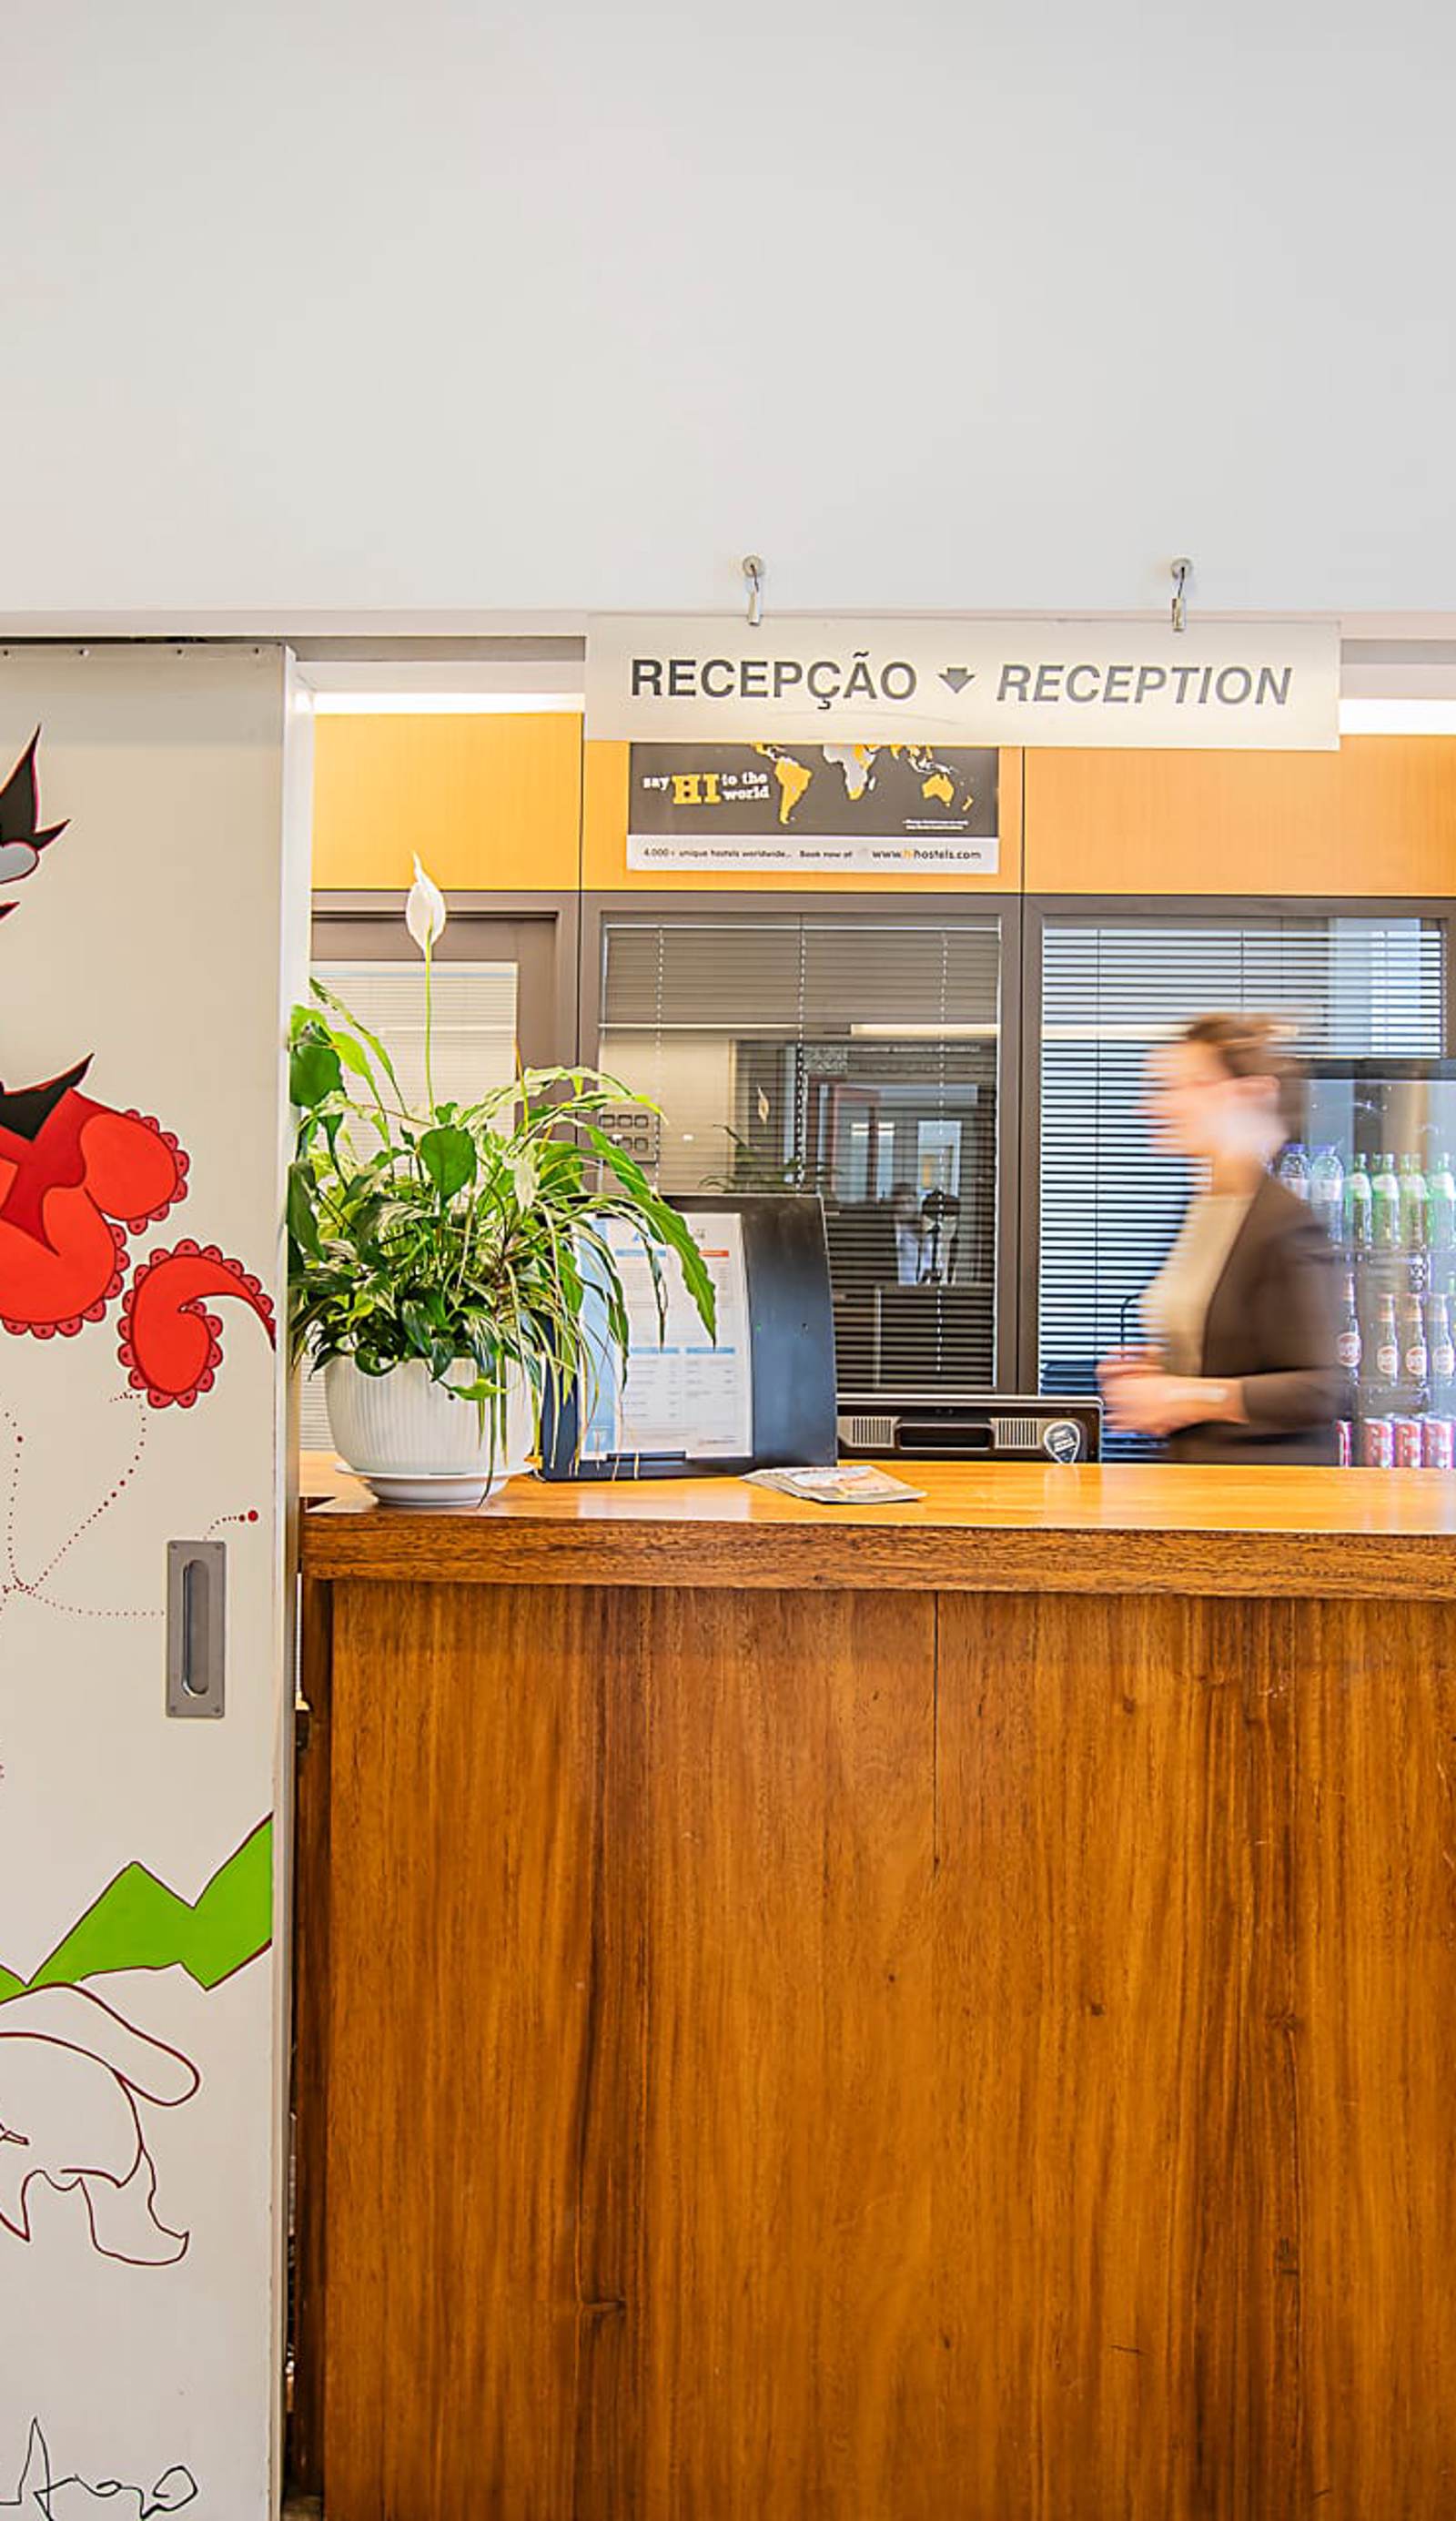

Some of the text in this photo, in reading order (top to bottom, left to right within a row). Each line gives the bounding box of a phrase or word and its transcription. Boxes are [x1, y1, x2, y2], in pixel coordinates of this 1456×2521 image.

[632, 651, 1292, 710] RECEPÇÃO RECEPTION
[642, 772, 767, 805] say HI to the
[723, 785, 770, 800] world
